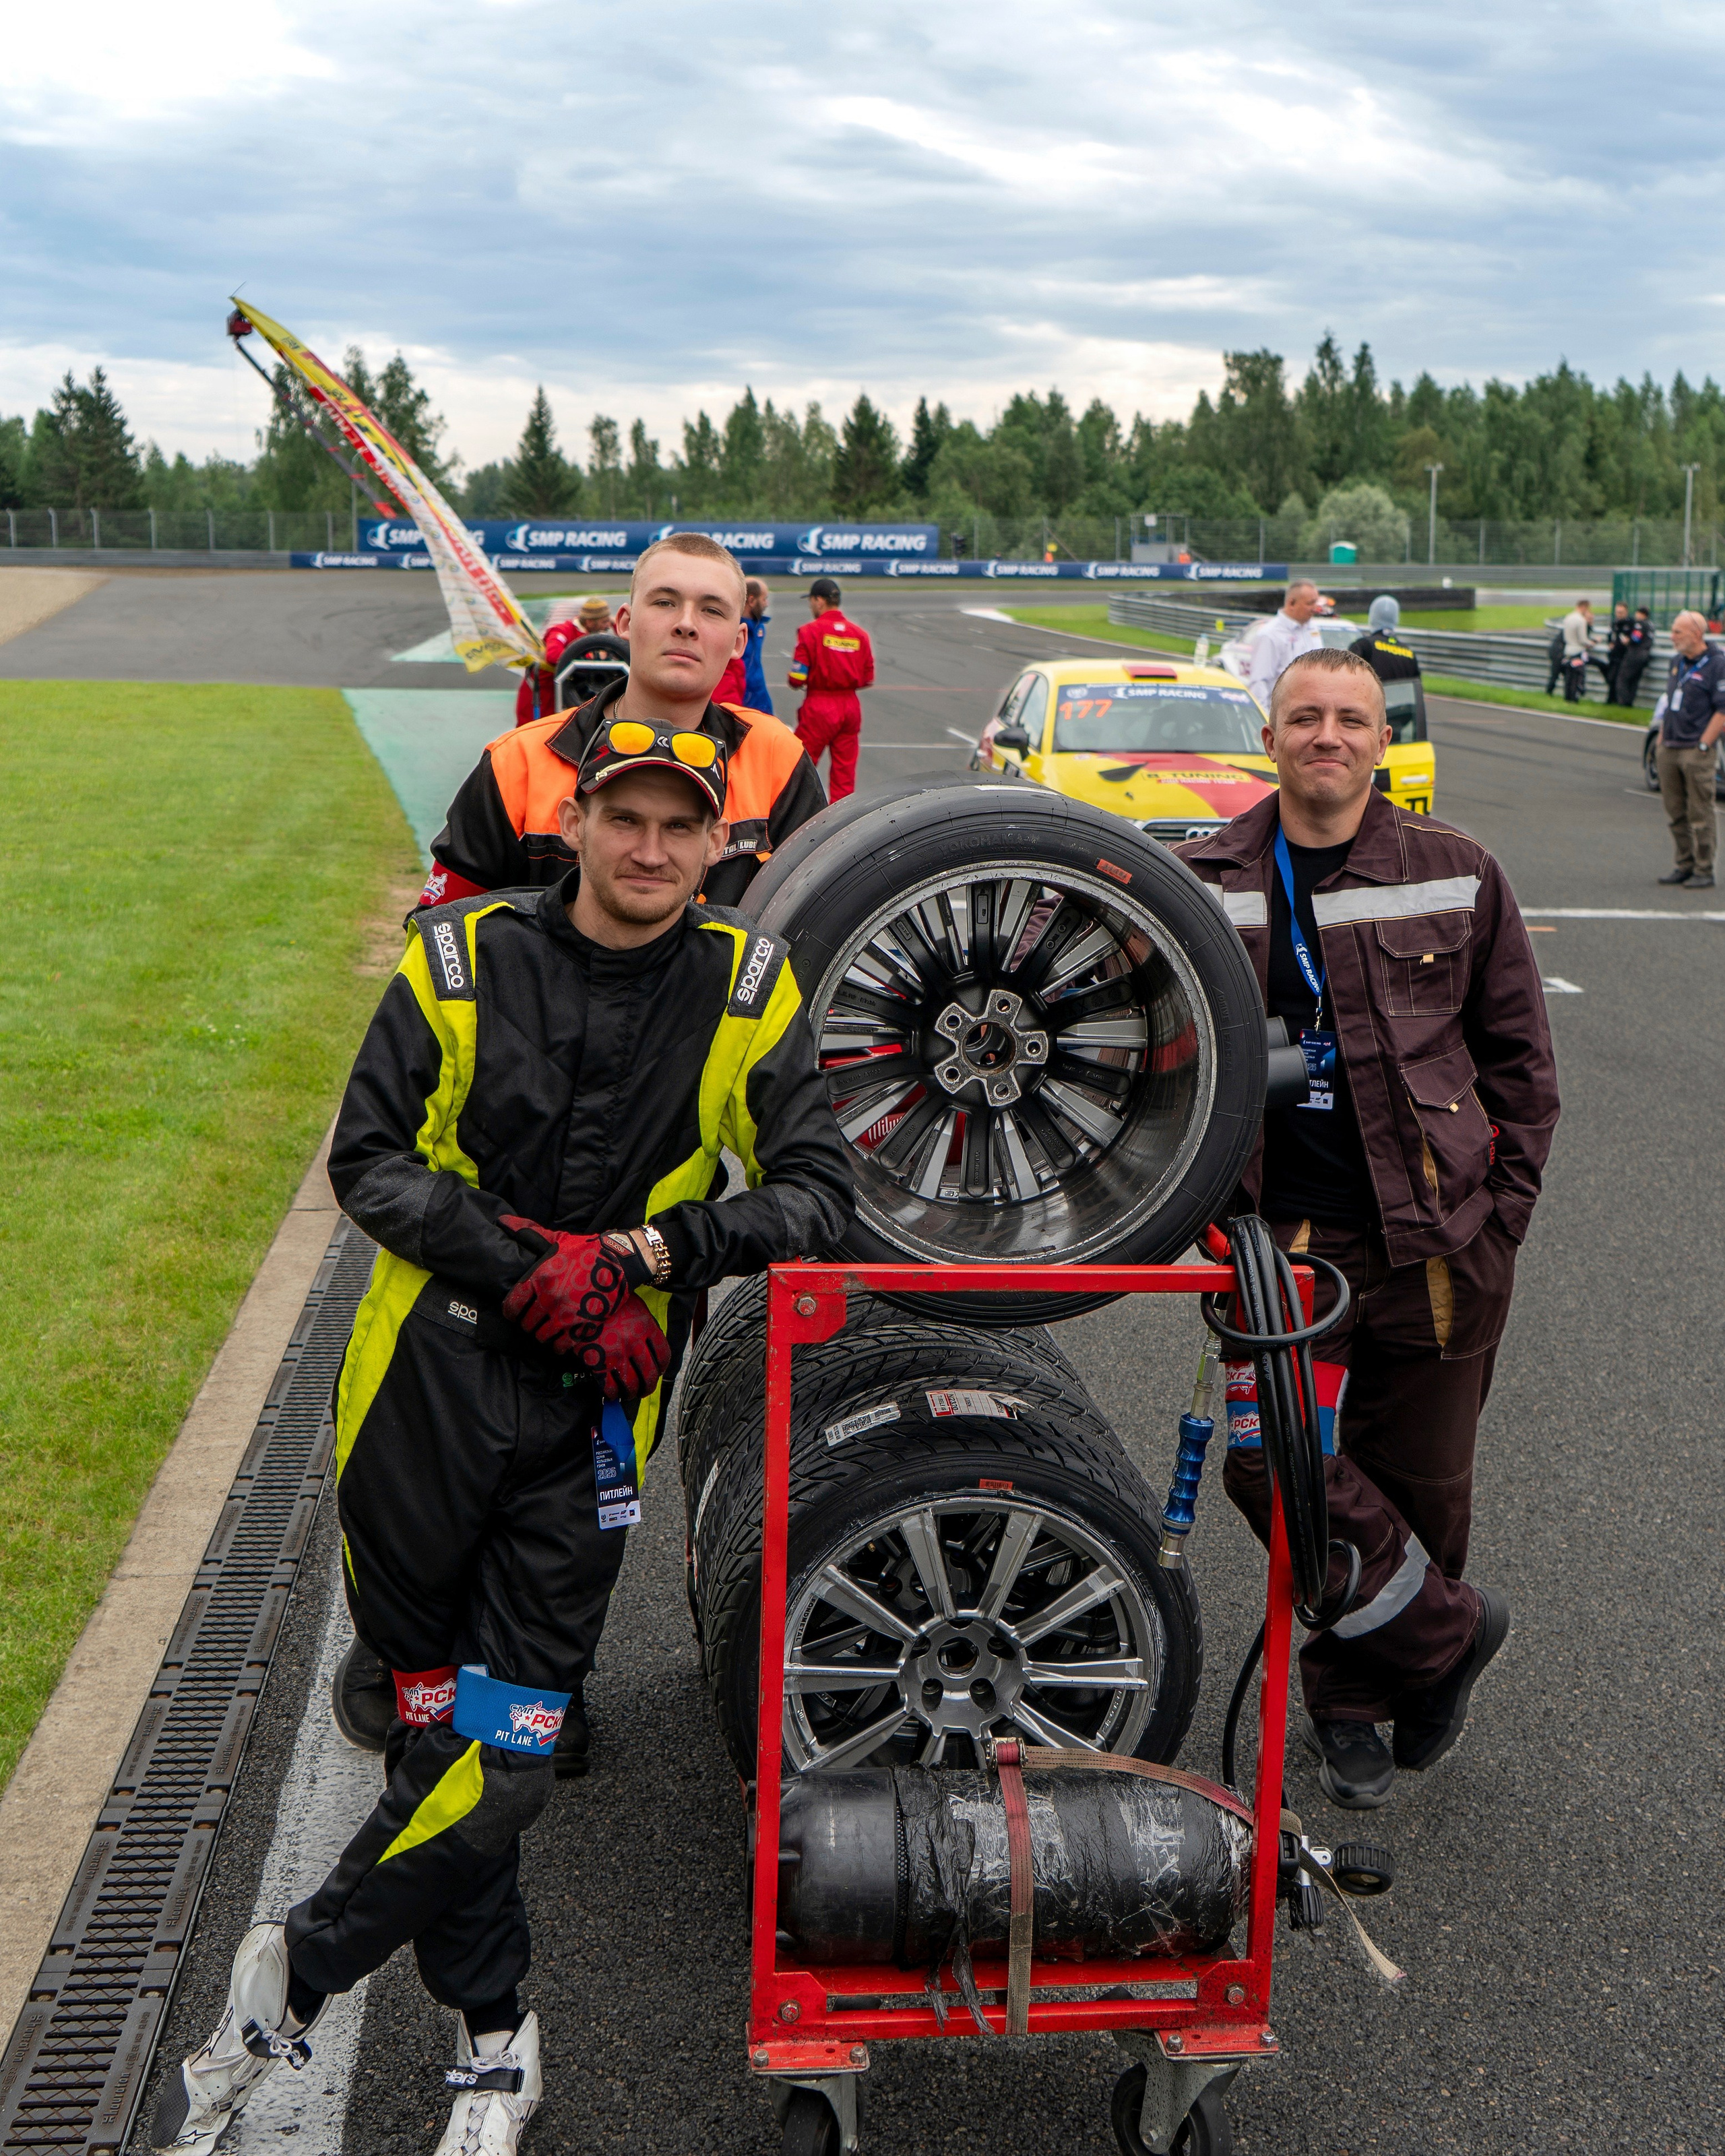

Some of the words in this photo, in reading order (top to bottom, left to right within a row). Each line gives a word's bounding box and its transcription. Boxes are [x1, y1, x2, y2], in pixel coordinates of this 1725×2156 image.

[388, 528, 423, 546] SMP
[528, 530, 565, 548] SMP
[567, 530, 627, 549] RACING
[714, 532, 775, 550] RACING
[821, 534, 860, 550] SMP
[861, 534, 927, 551] RACING
[323, 556, 342, 567] SMP
[343, 557, 378, 567] RACING
[410, 557, 431, 568] SMP
[499, 559, 519, 569] SMP
[520, 559, 555, 569] RACING
[590, 560, 611, 570] SMP
[801, 562, 820, 573] SMP
[821, 563, 862, 573] RACING
[898, 563, 917, 574] SMP
[918, 563, 960, 575] RACING
[996, 565, 1019, 575] SMP
[1020, 565, 1059, 577] RACING
[1097, 565, 1119, 576] SMP
[1119, 565, 1160, 577] RACING
[1199, 566, 1221, 577] SMP
[1222, 567, 1263, 579] RACING
[1128, 689, 1156, 697] SMP
[1158, 689, 1208, 700] RACING
[1059, 699, 1112, 720] 177
[722, 844, 737, 855] TAL
[433, 922, 465, 990] sparco
[1300, 953, 1311, 969] SMP
[736, 938, 774, 1005] sparco
[1309, 1079, 1329, 1089] ТЛЕЙН
[598, 1467, 617, 1480] 2025
[600, 1485, 633, 1501] ПИТЛЕЙН
[796, 1598, 816, 1642] FONDMETAL
[509, 1703, 534, 1715] СМП
[406, 1711, 414, 1720] PIT
[414, 1713, 431, 1723] LANE
[495, 1730, 510, 1742] PIT
[511, 1732, 534, 1747] LANE
